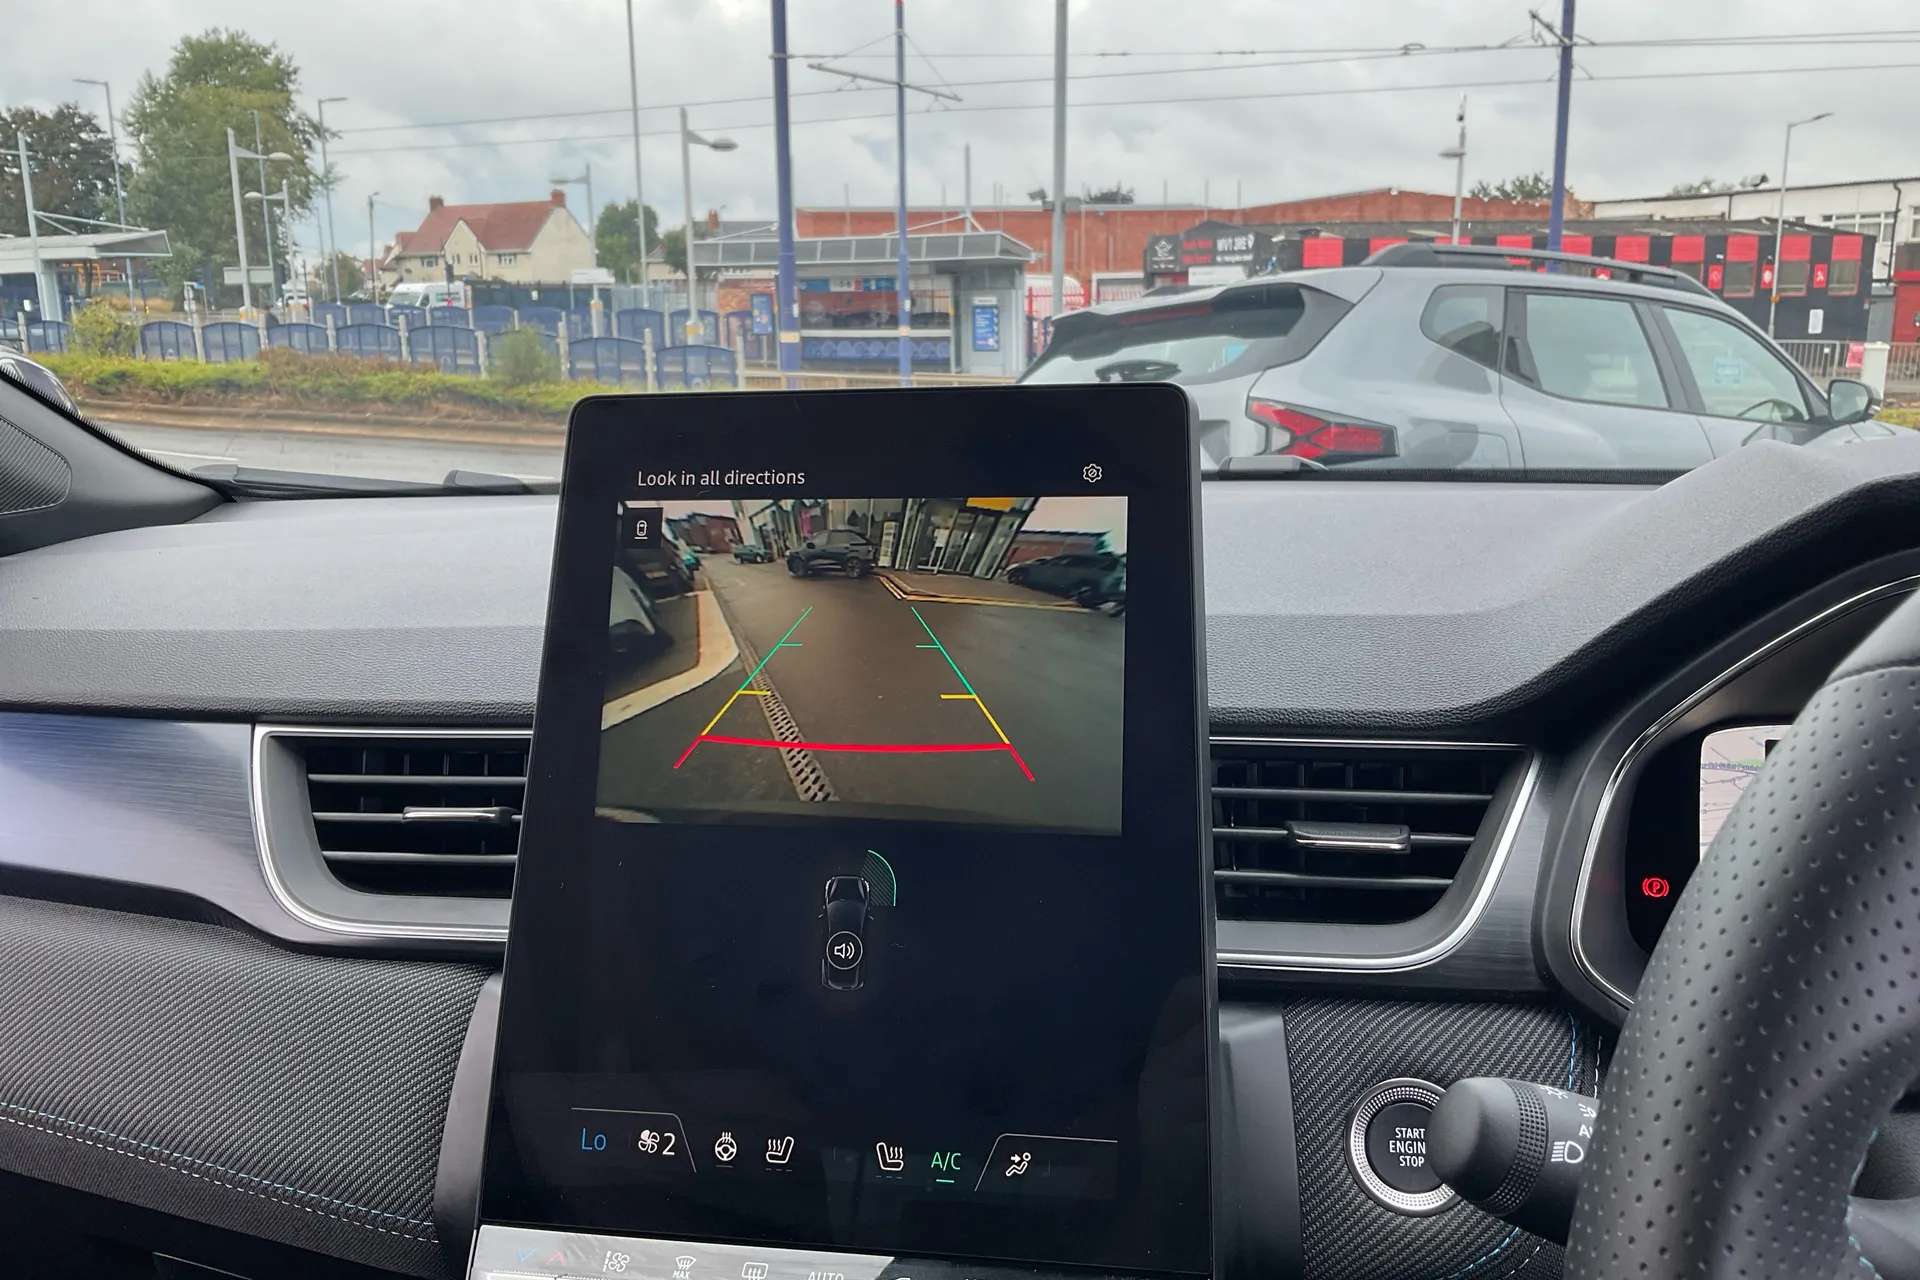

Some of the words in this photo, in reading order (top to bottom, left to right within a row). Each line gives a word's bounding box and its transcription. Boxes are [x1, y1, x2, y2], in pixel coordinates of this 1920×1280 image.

[637, 470, 677, 486] Look
[680, 470, 696, 486] in
[700, 470, 720, 486] all
[724, 469, 806, 486] directions
[580, 1127, 607, 1151] Lo
[1395, 1127, 1426, 1139] START
[662, 1132, 676, 1155] 2
[1389, 1140, 1426, 1154] ENGIN
[930, 1151, 961, 1171] A/C
[1399, 1155, 1425, 1167] STOP
[672, 1269, 691, 1280] MAX
